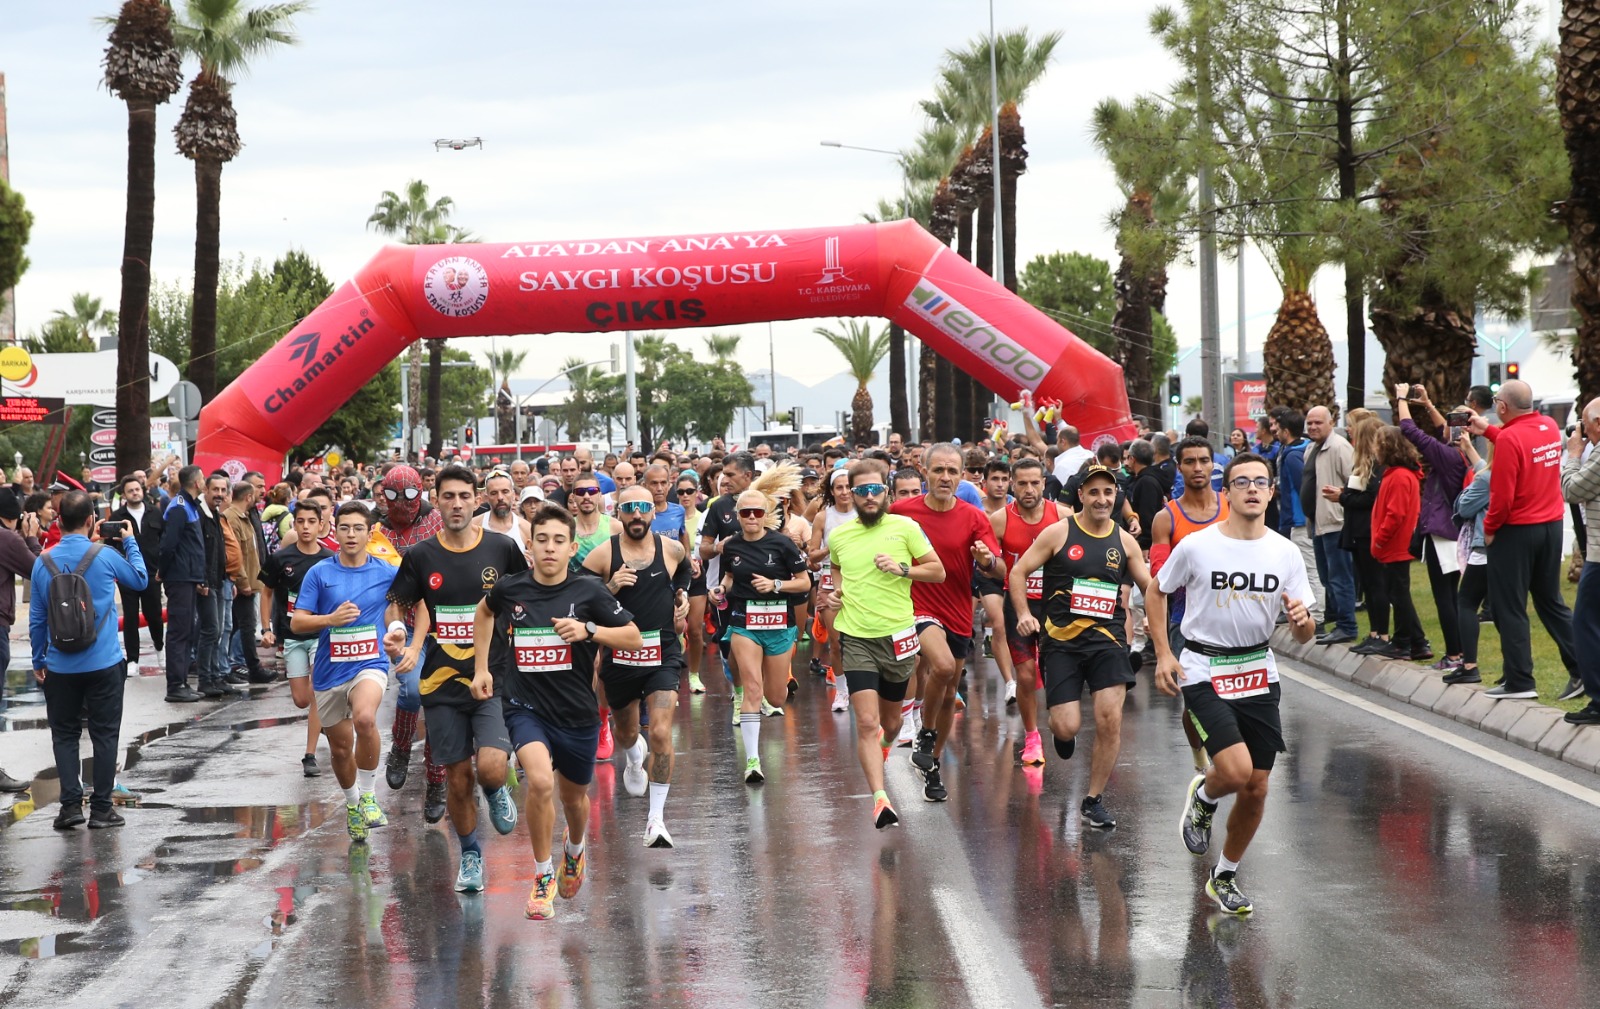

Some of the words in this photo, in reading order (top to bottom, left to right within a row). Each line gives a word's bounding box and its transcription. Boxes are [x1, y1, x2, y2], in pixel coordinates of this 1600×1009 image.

[501, 239, 649, 258] ATA'DAN
[658, 233, 788, 253] ANA'YA
[518, 268, 621, 292] SAYGI
[631, 261, 778, 292] KOŞUSU
[426, 292, 450, 315] SAYGI
[454, 293, 487, 317] KOŞUSU
[585, 298, 706, 328] ÇIKIŞ
[264, 318, 376, 414] Chamartin
[1211, 571, 1280, 593] BOLD
[1073, 596, 1113, 612] 35467
[749, 614, 784, 624] 36179
[333, 641, 375, 655] 35037
[518, 648, 567, 663] 35297
[615, 648, 658, 660] 35322
[1215, 672, 1264, 693] 35077
